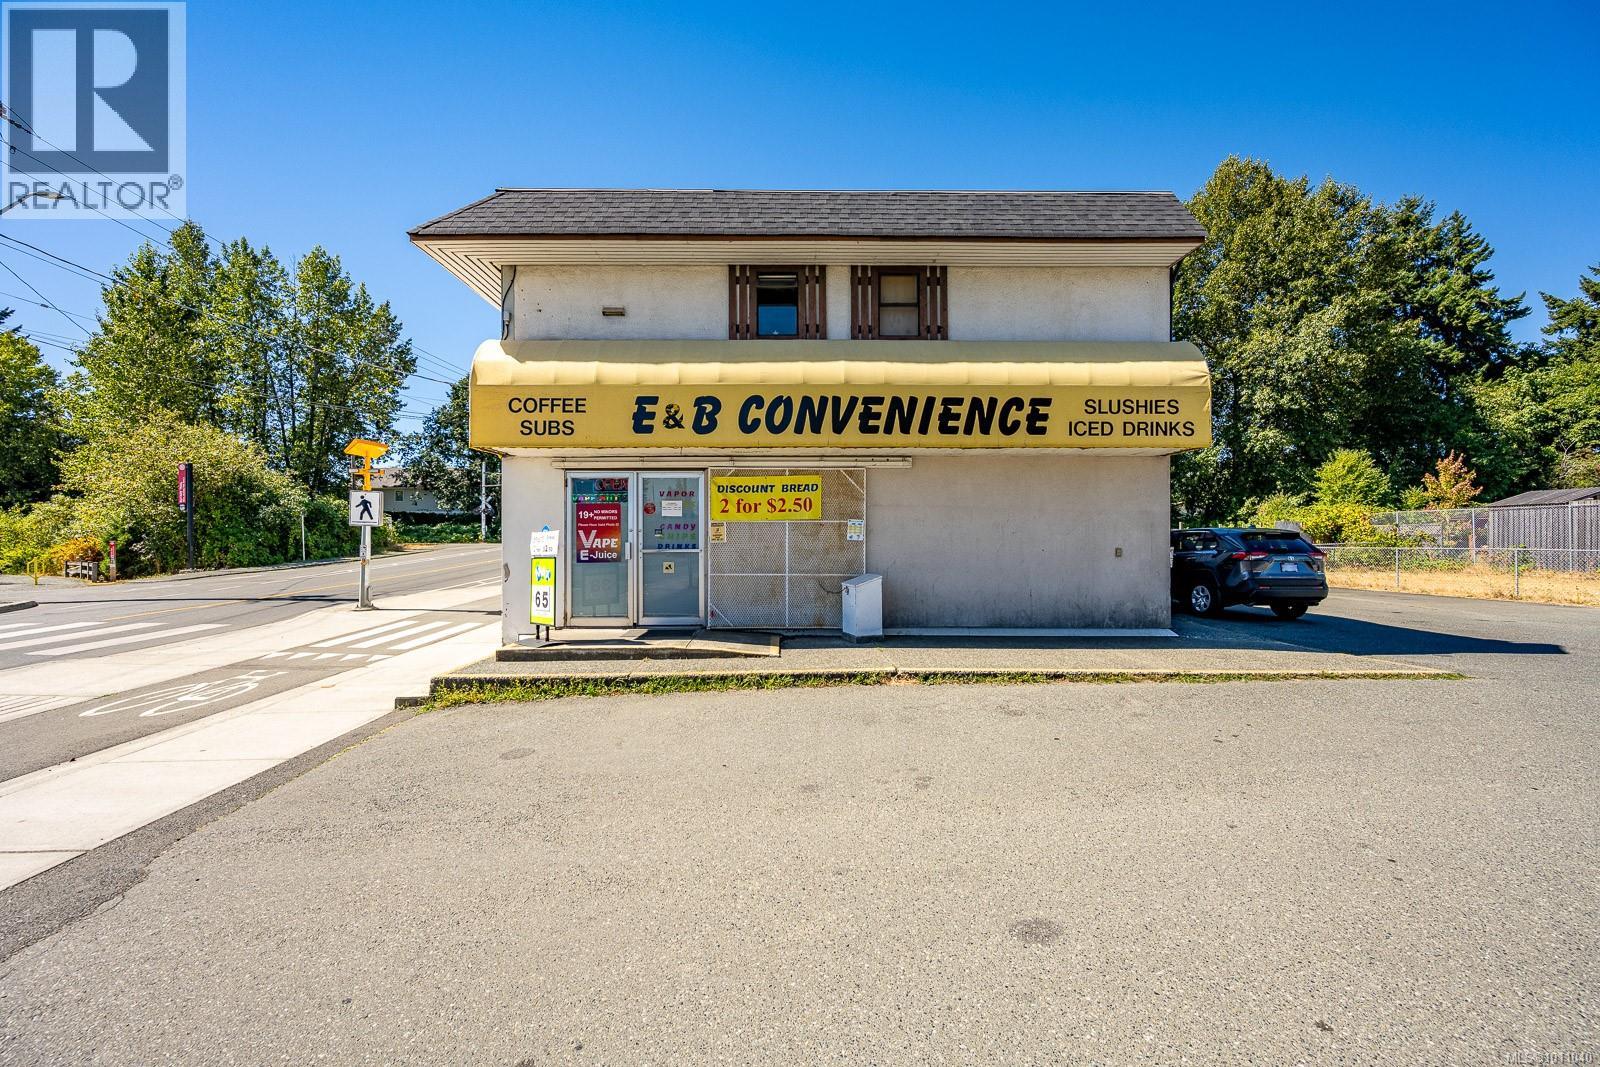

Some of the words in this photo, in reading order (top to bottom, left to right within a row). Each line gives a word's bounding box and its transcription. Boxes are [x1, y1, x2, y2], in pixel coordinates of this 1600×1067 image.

[508, 398, 587, 413] COFFEE
[1084, 399, 1179, 415] SLUSHIES
[738, 395, 1052, 435] CONVENIENCE
[520, 420, 575, 436] SUBS
[1069, 421, 1113, 437] ICED
[1122, 421, 1195, 437] DRINKS
[717, 485, 775, 493] DISCOUNT
[781, 484, 819, 492] BREAD
[720, 499, 729, 513] 2
[736, 498, 761, 513] for
[767, 497, 813, 513] $2.50
[578, 510, 594, 519] 19+
[660, 523, 696, 531] CANDY
[580, 550, 618, 560] E-Juice
[535, 591, 548, 608] 65
